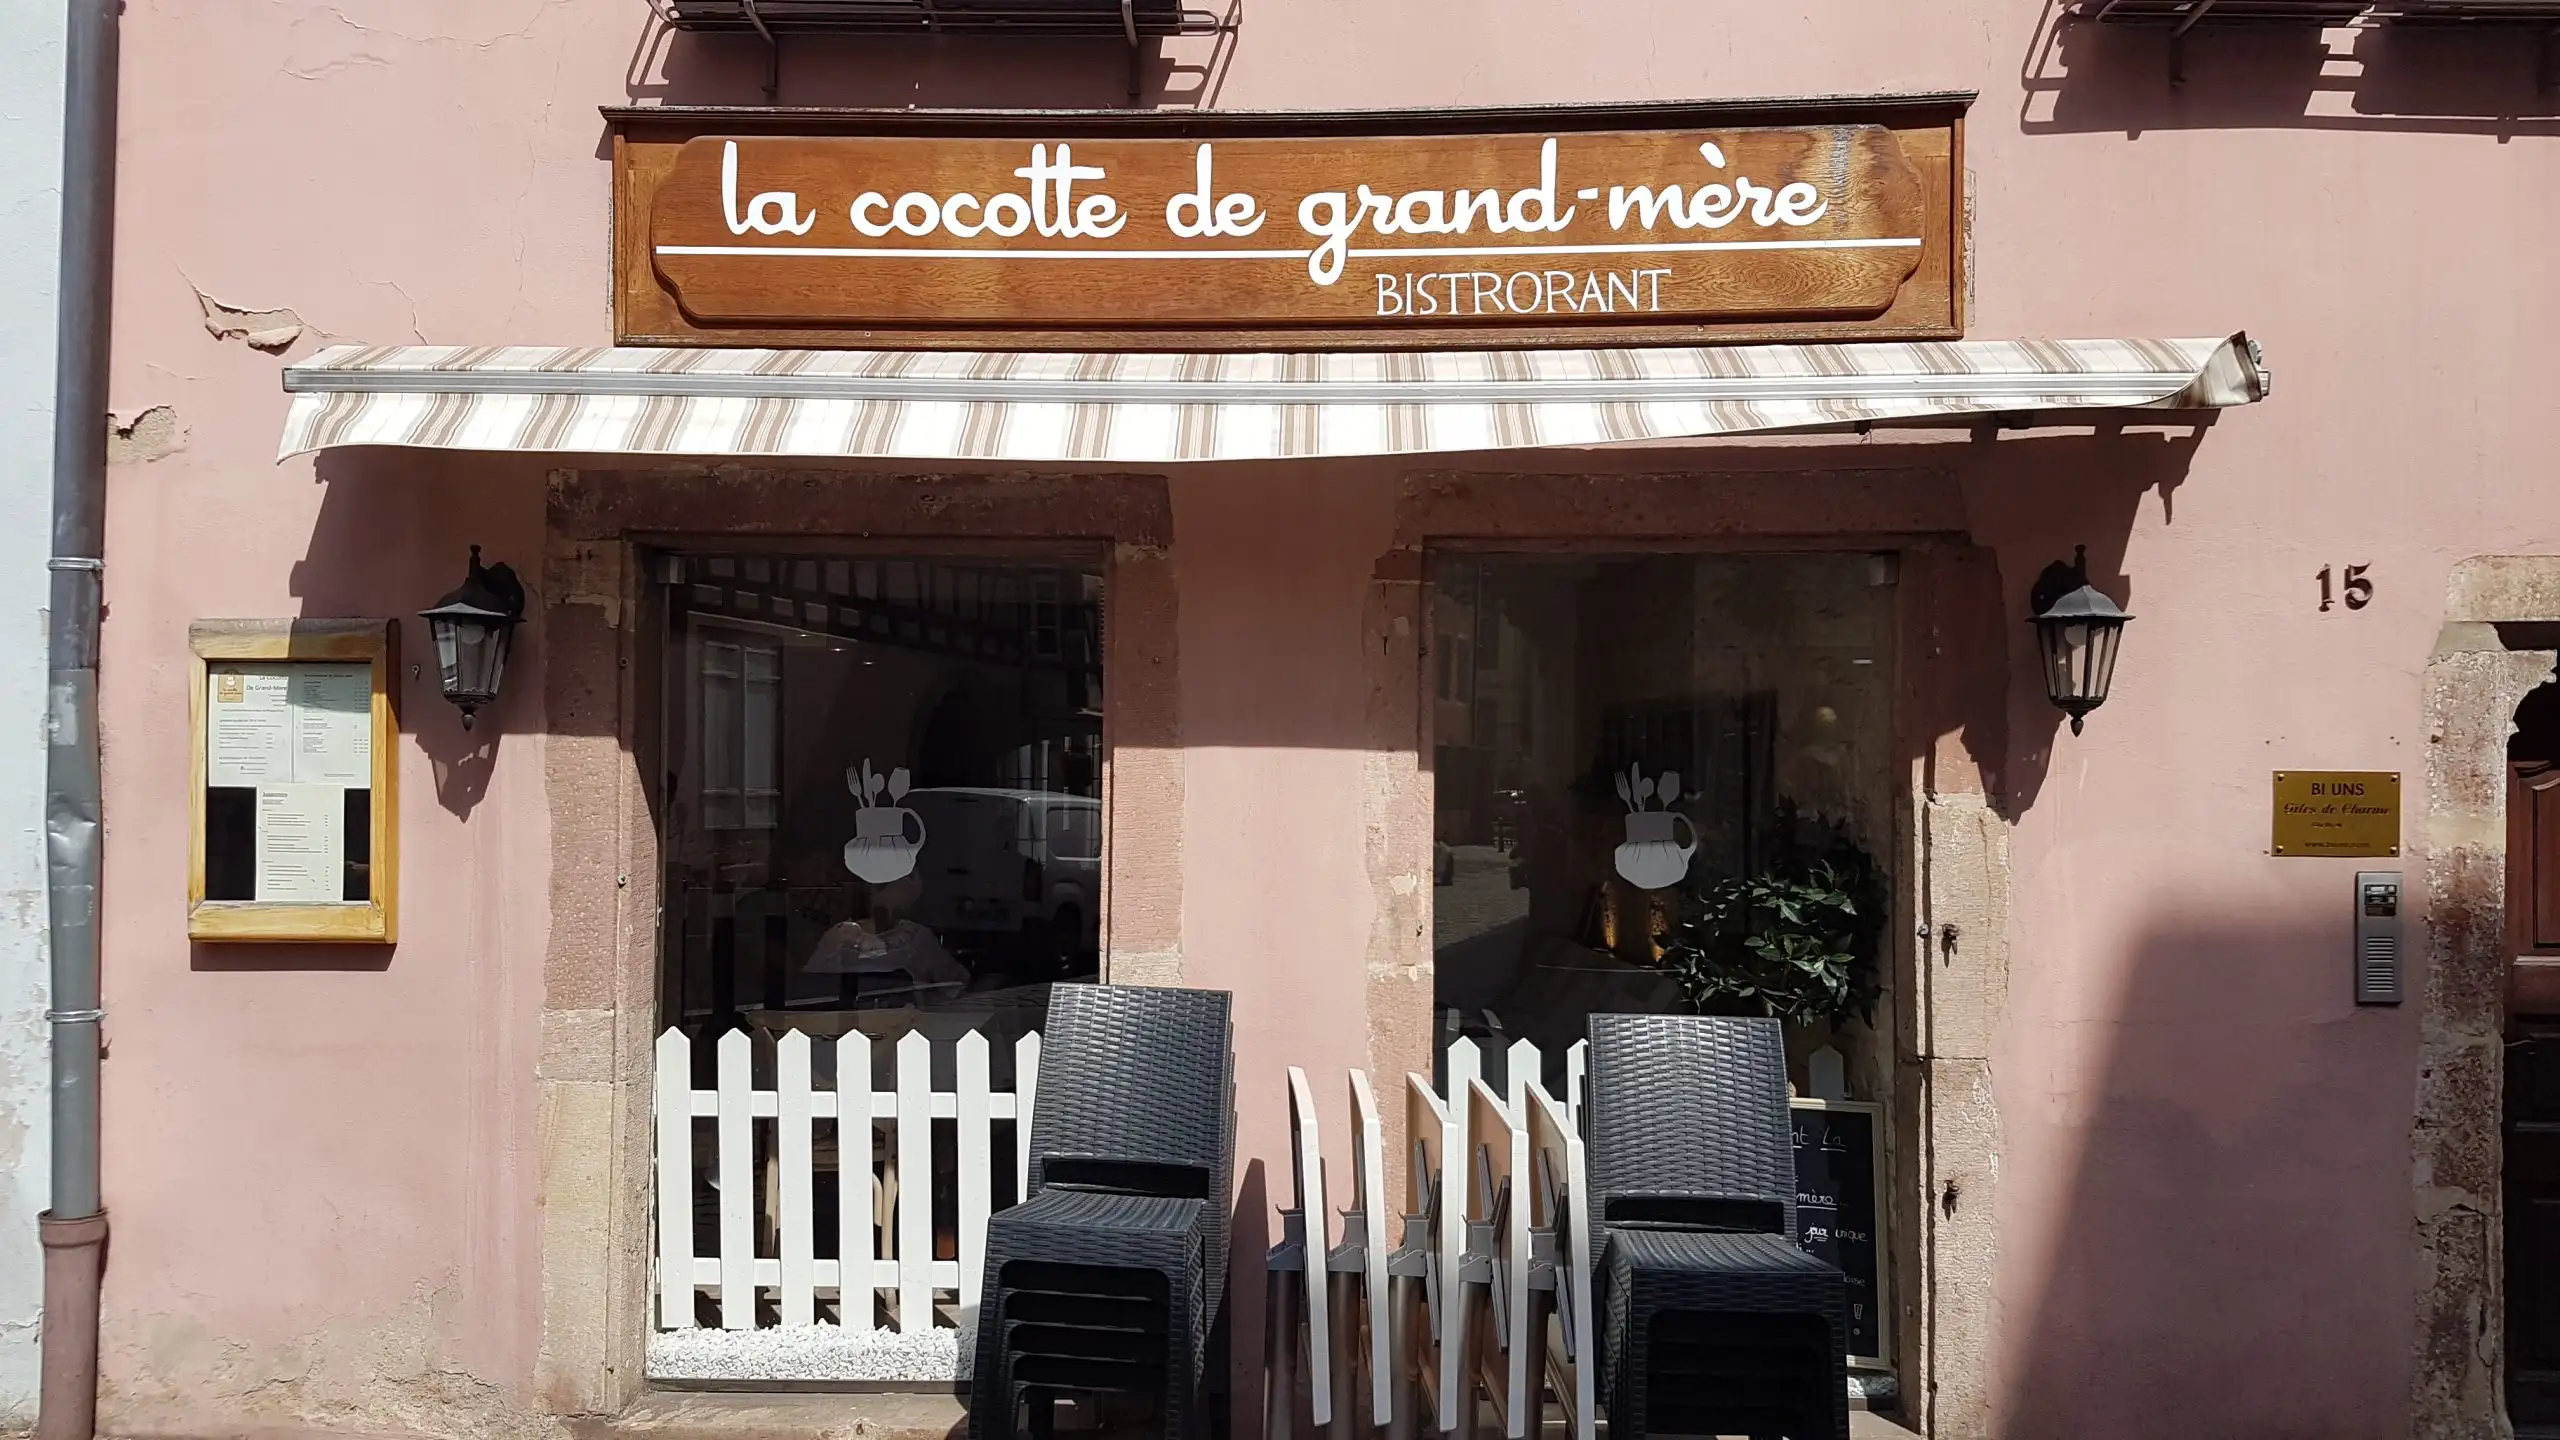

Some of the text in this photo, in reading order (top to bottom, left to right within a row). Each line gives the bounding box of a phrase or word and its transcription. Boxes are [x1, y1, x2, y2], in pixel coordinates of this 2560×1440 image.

[721, 137, 1828, 287] la cocotte de grand-mère
[1376, 267, 1672, 316] BISTRORANT
[2316, 561, 2373, 612] 15
[2311, 782, 2365, 796] BI UNS
[1835, 1226, 1868, 1243] unique
